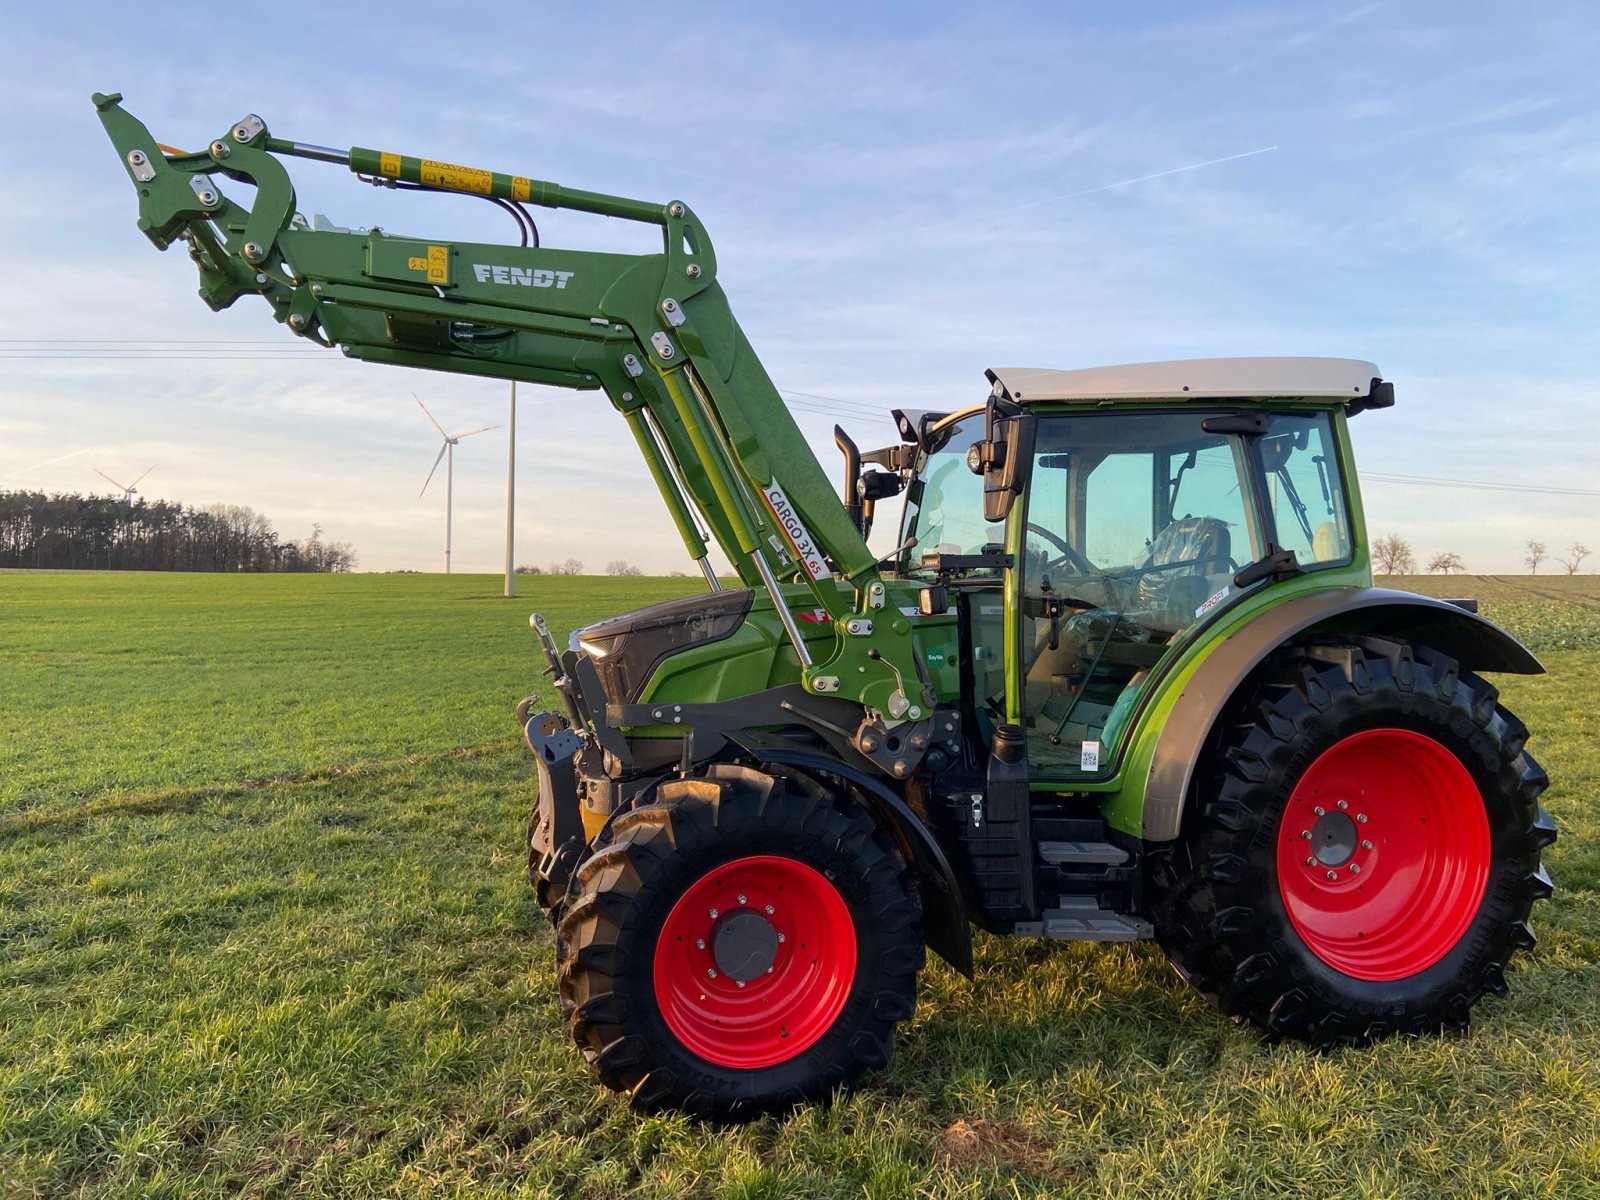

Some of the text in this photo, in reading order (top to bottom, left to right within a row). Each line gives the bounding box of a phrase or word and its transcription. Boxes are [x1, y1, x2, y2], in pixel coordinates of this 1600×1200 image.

[473, 264, 575, 289] FENDT
[769, 491, 802, 539] CARGO
[797, 539, 815, 560] 3X
[809, 560, 822, 575] 65
[1201, 591, 1224, 612] PROFI
